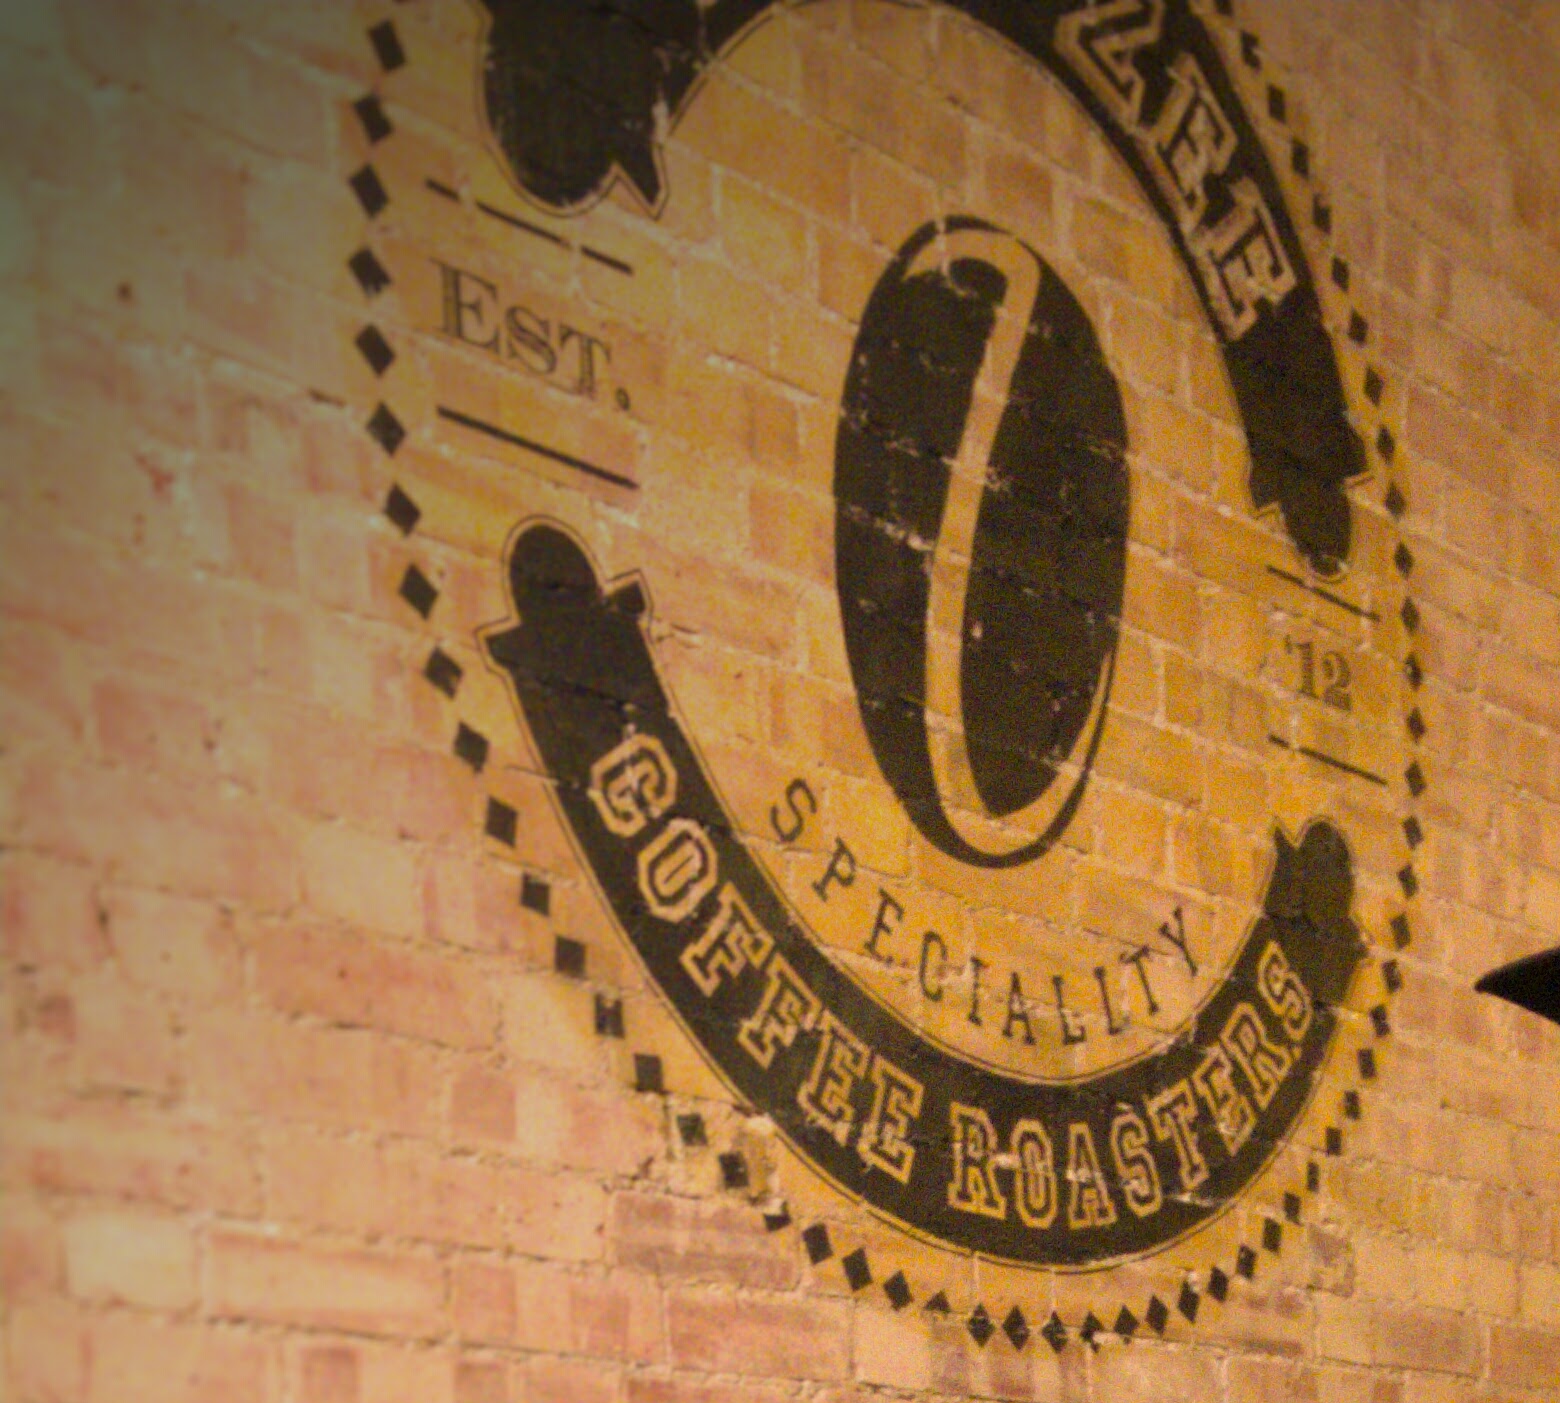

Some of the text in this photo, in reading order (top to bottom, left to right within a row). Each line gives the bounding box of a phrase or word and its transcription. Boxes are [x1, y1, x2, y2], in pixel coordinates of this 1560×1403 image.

[430, 257, 631, 412] EST.
[587, 732, 1314, 1230] COFFEE ROASTERS
[769, 776, 1199, 1047] SPECIALITY
